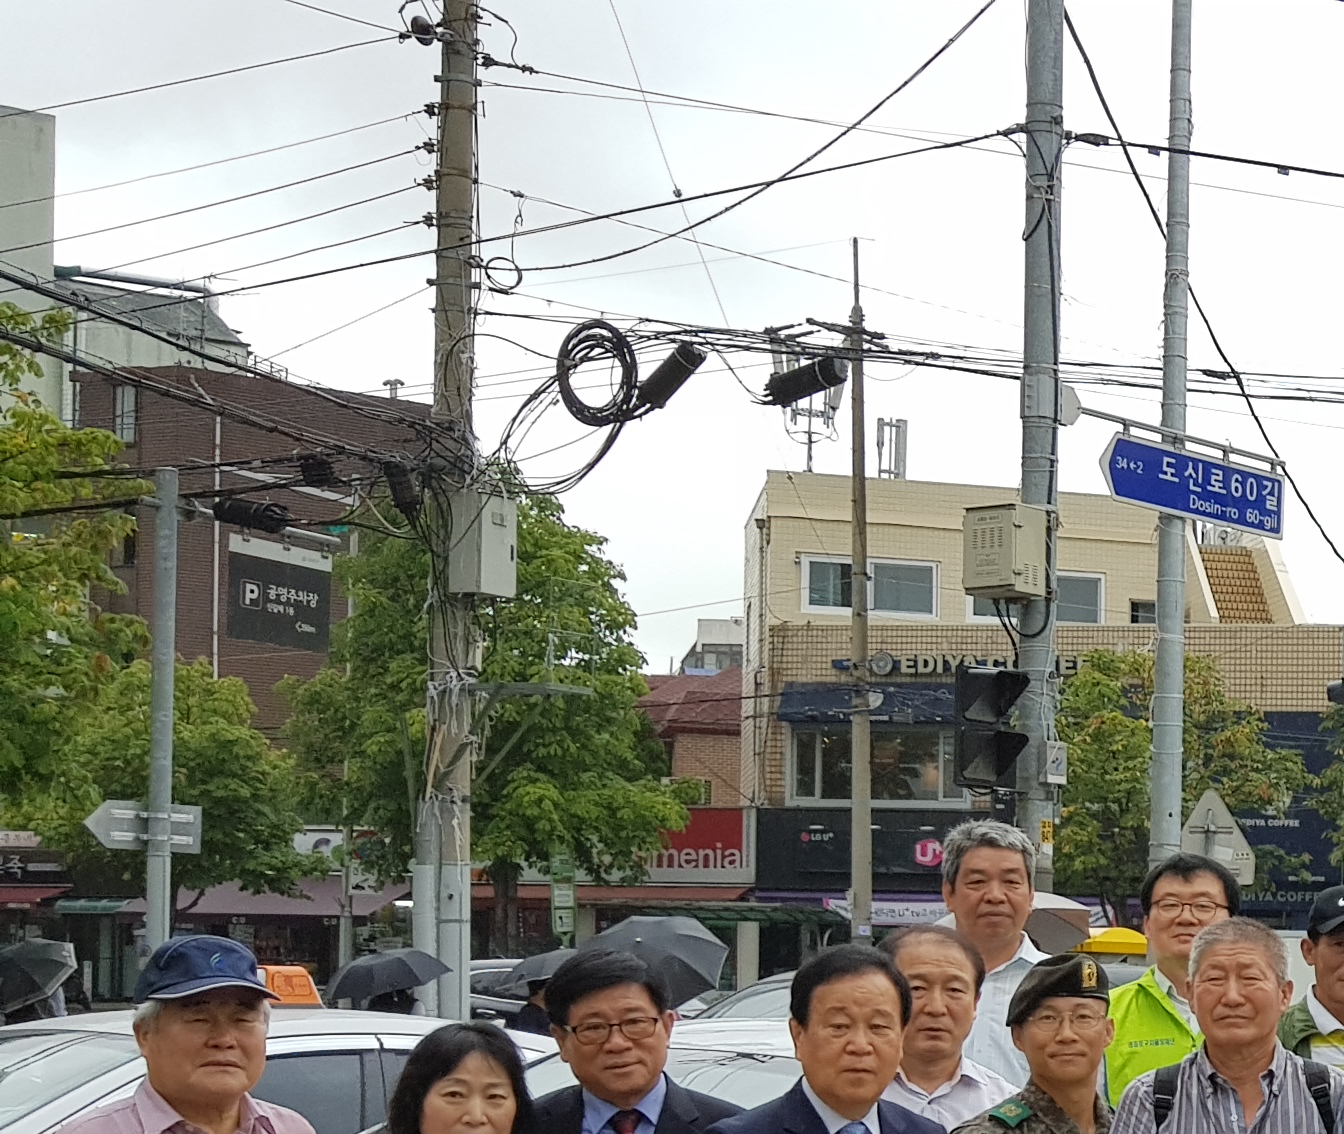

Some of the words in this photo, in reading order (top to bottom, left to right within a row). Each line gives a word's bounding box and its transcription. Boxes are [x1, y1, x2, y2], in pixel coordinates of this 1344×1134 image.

[1115, 456, 1128, 470] 34
[1158, 455, 1279, 512] 도신로60길
[1189, 495, 1239, 520] Dosin-ro
[1246, 509, 1278, 531] 60-gil
